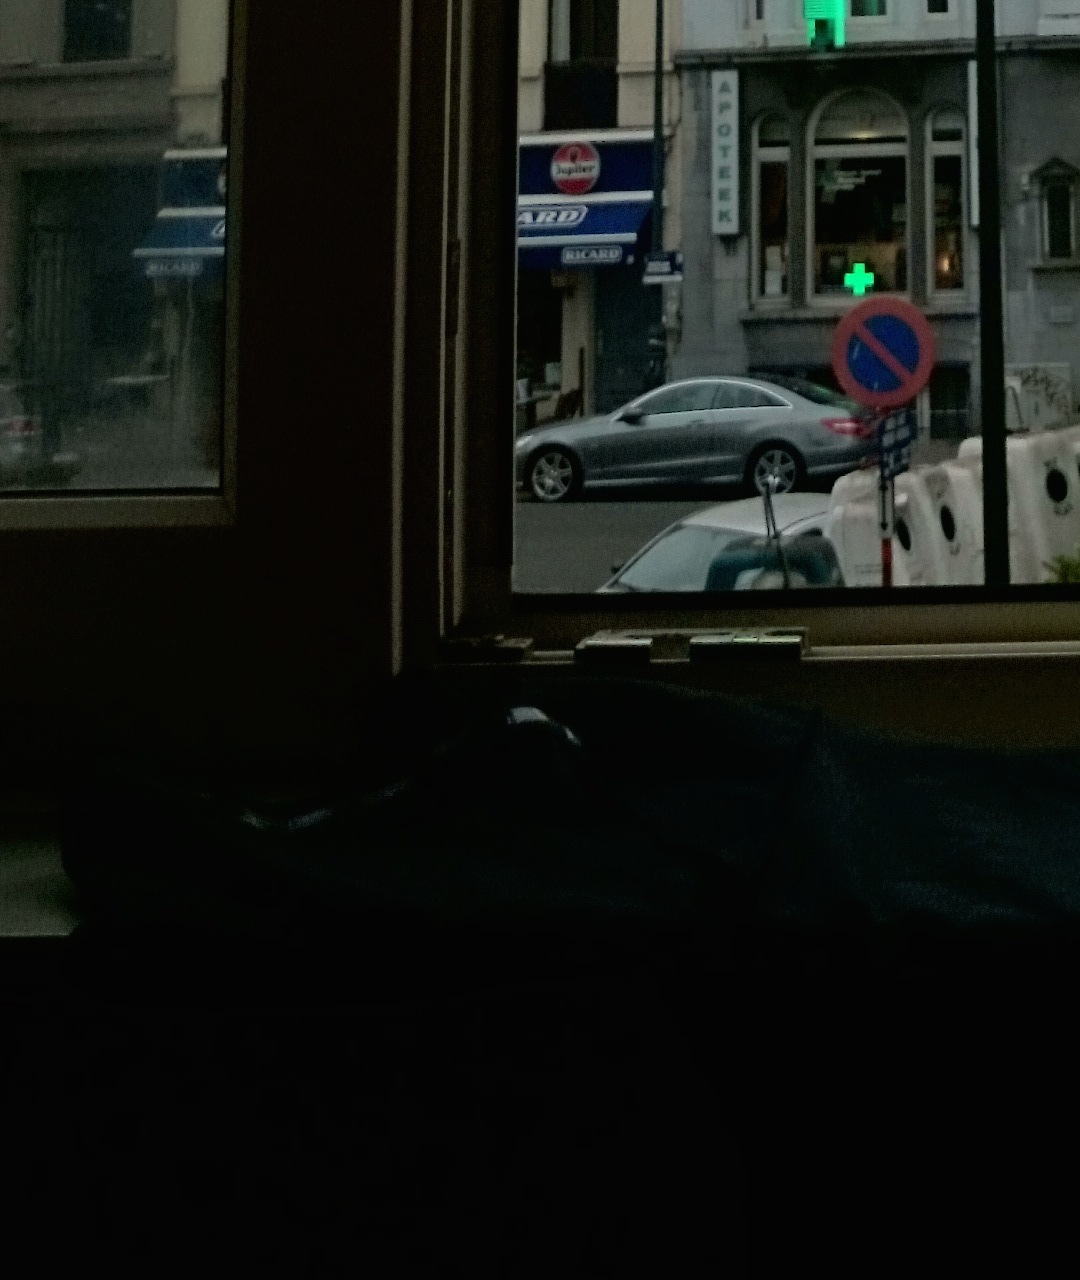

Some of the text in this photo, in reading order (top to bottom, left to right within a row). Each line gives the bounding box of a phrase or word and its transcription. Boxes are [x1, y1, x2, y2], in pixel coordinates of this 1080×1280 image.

[717, 79, 732, 224] APOTEEK
[517, 209, 580, 225] ARD
[565, 249, 619, 261] RICARD
